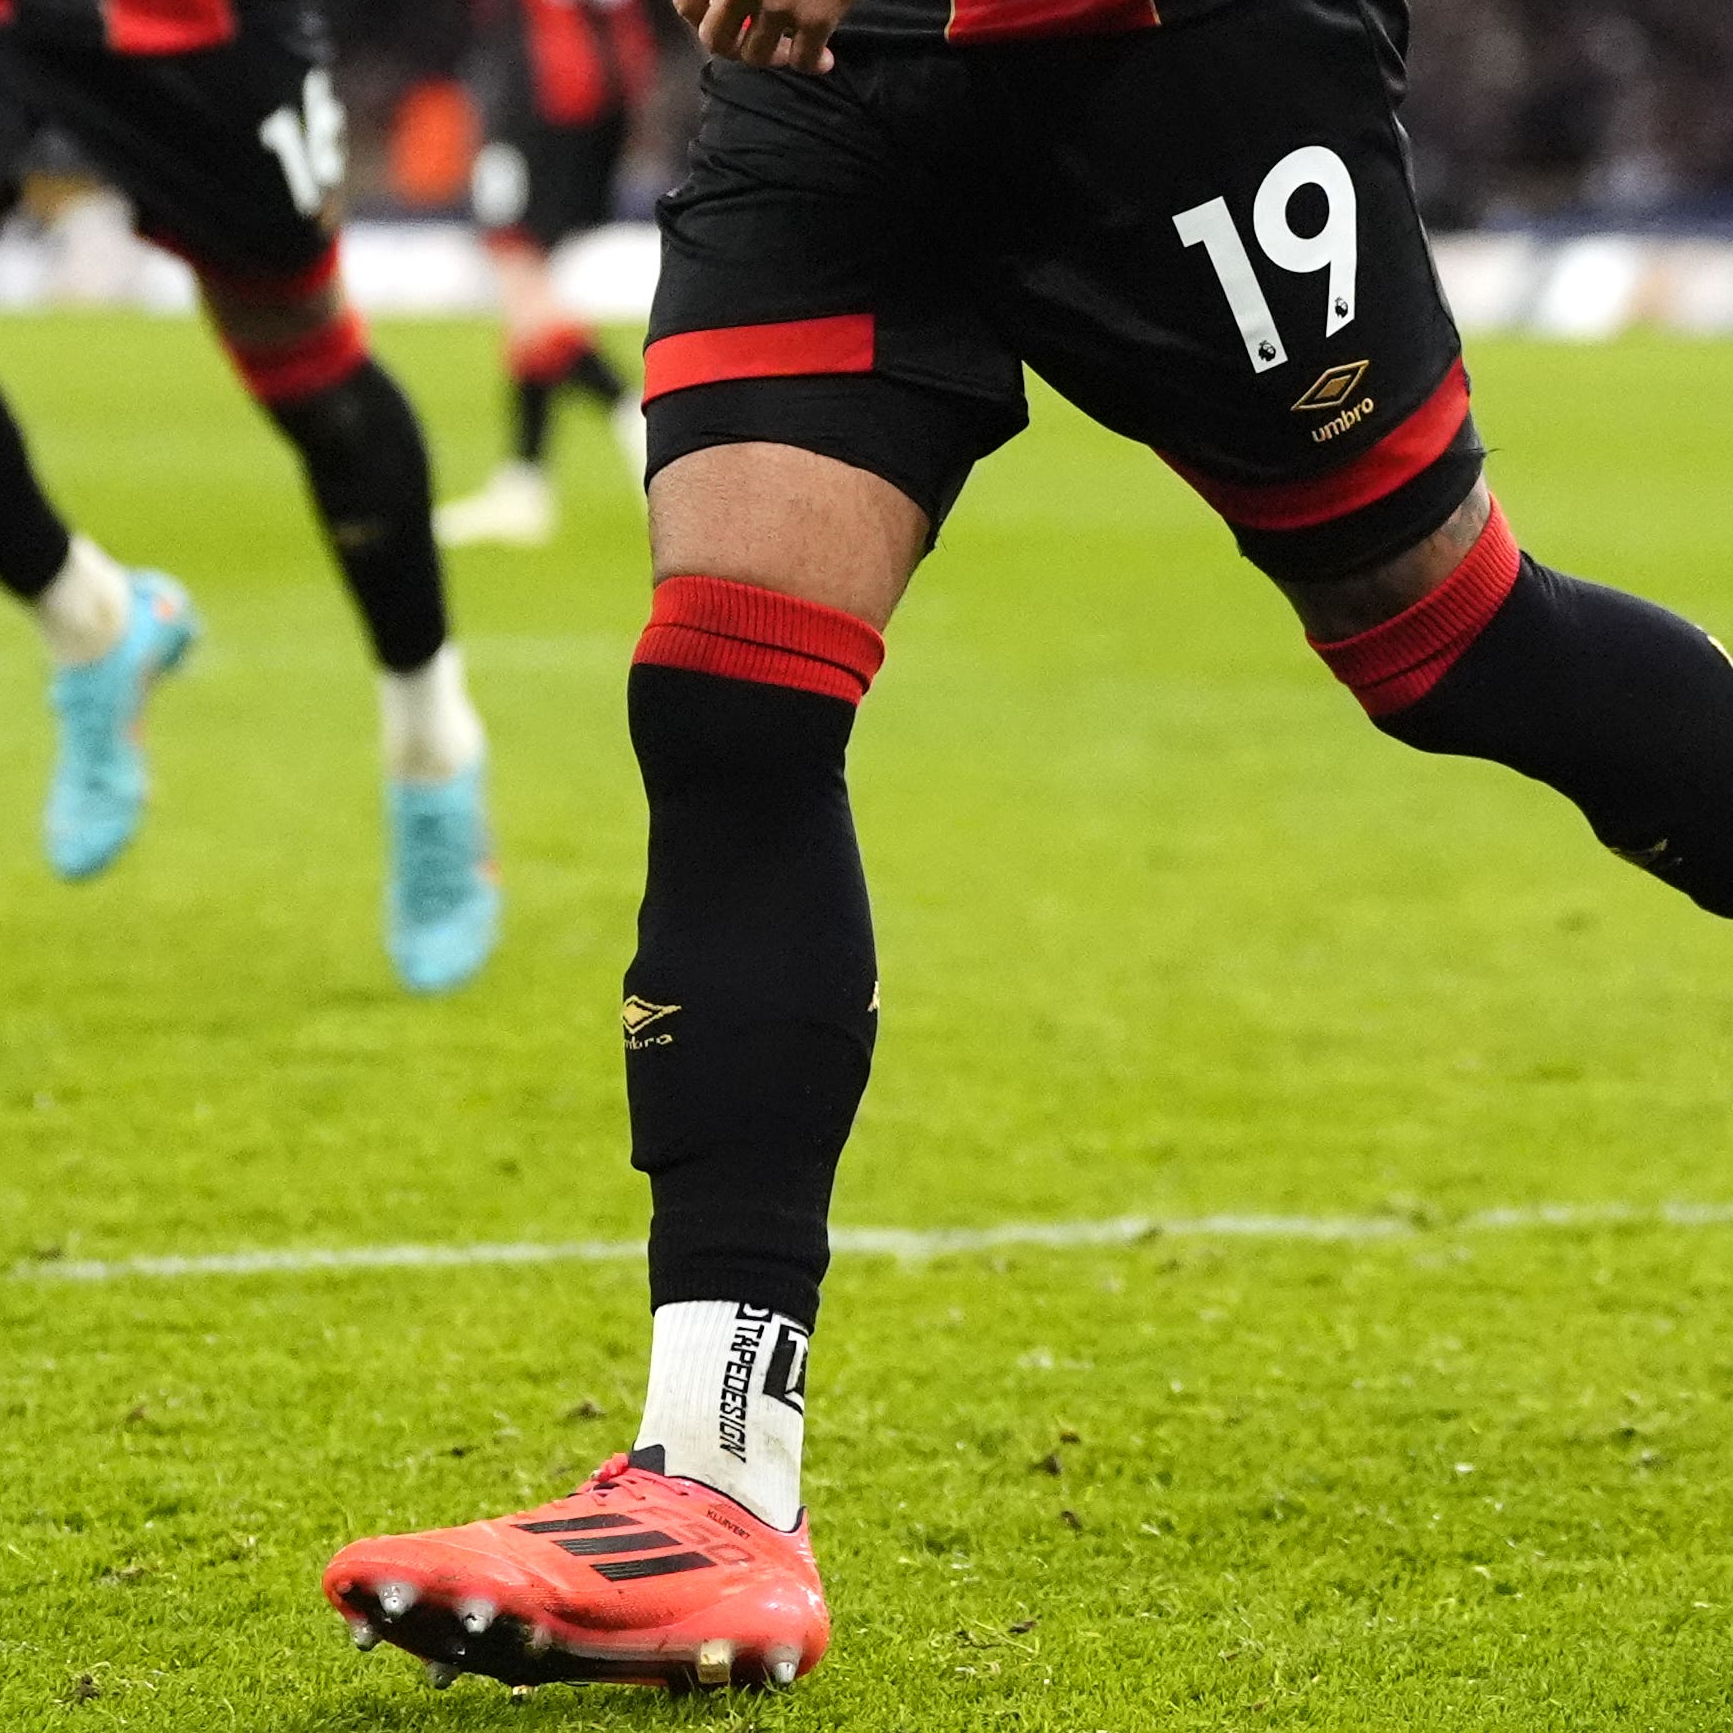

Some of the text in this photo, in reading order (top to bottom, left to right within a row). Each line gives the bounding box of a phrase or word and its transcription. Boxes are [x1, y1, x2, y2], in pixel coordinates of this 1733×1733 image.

[1171, 144, 1358, 375] 19
[1310, 395, 1376, 444] umbro
[625, 1033, 673, 1050] bro
[718, 1322, 766, 1464] TAPEDESIGN
